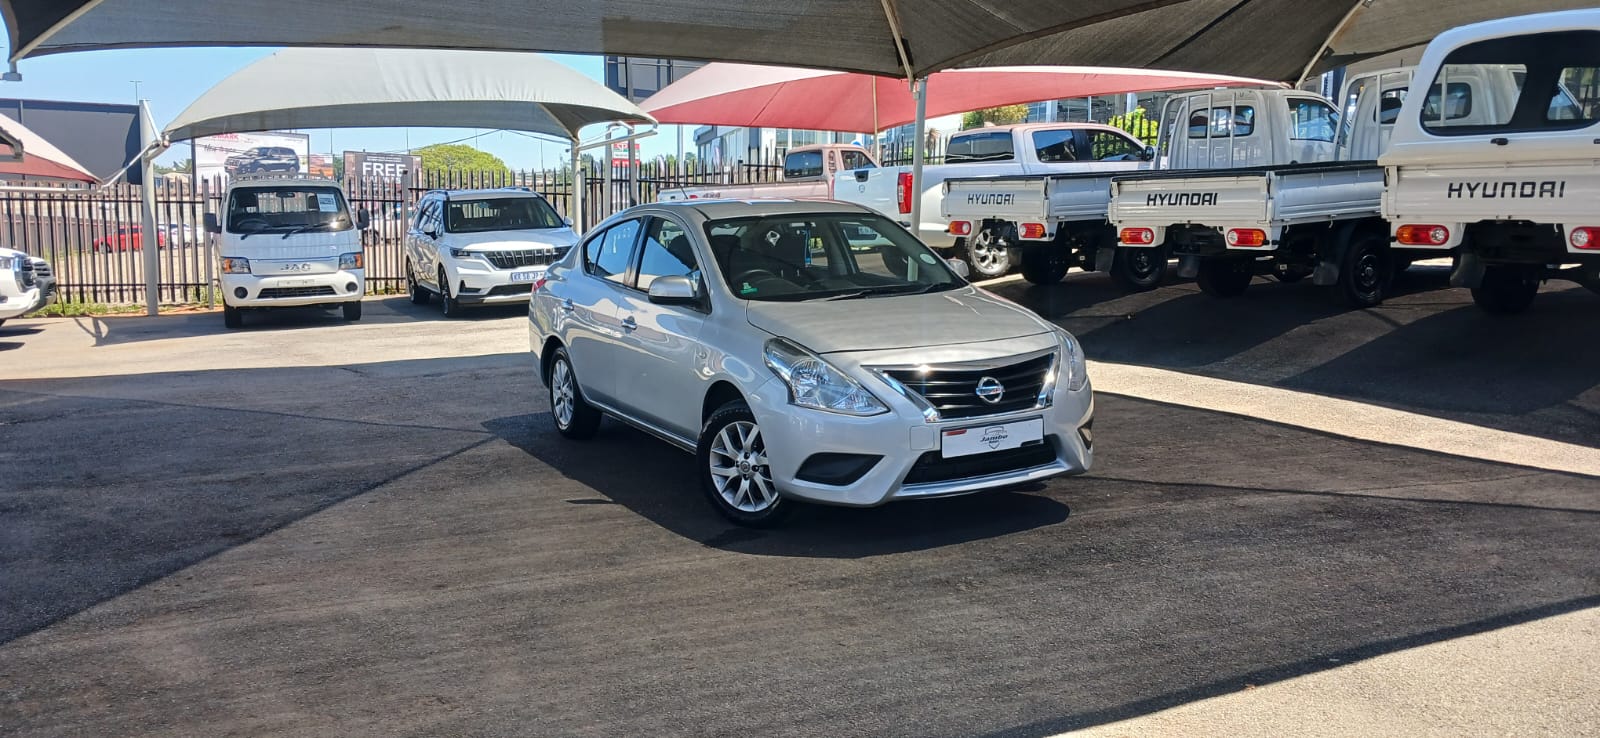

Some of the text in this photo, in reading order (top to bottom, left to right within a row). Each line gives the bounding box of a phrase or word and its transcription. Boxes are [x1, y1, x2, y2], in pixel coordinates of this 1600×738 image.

[362, 162, 407, 177] FREE
[1448, 181, 1566, 198] HYUNDAI
[967, 193, 1015, 205] HYUNDAI
[1146, 192, 1218, 206] HYUNDAI
[280, 263, 311, 272] JAC
